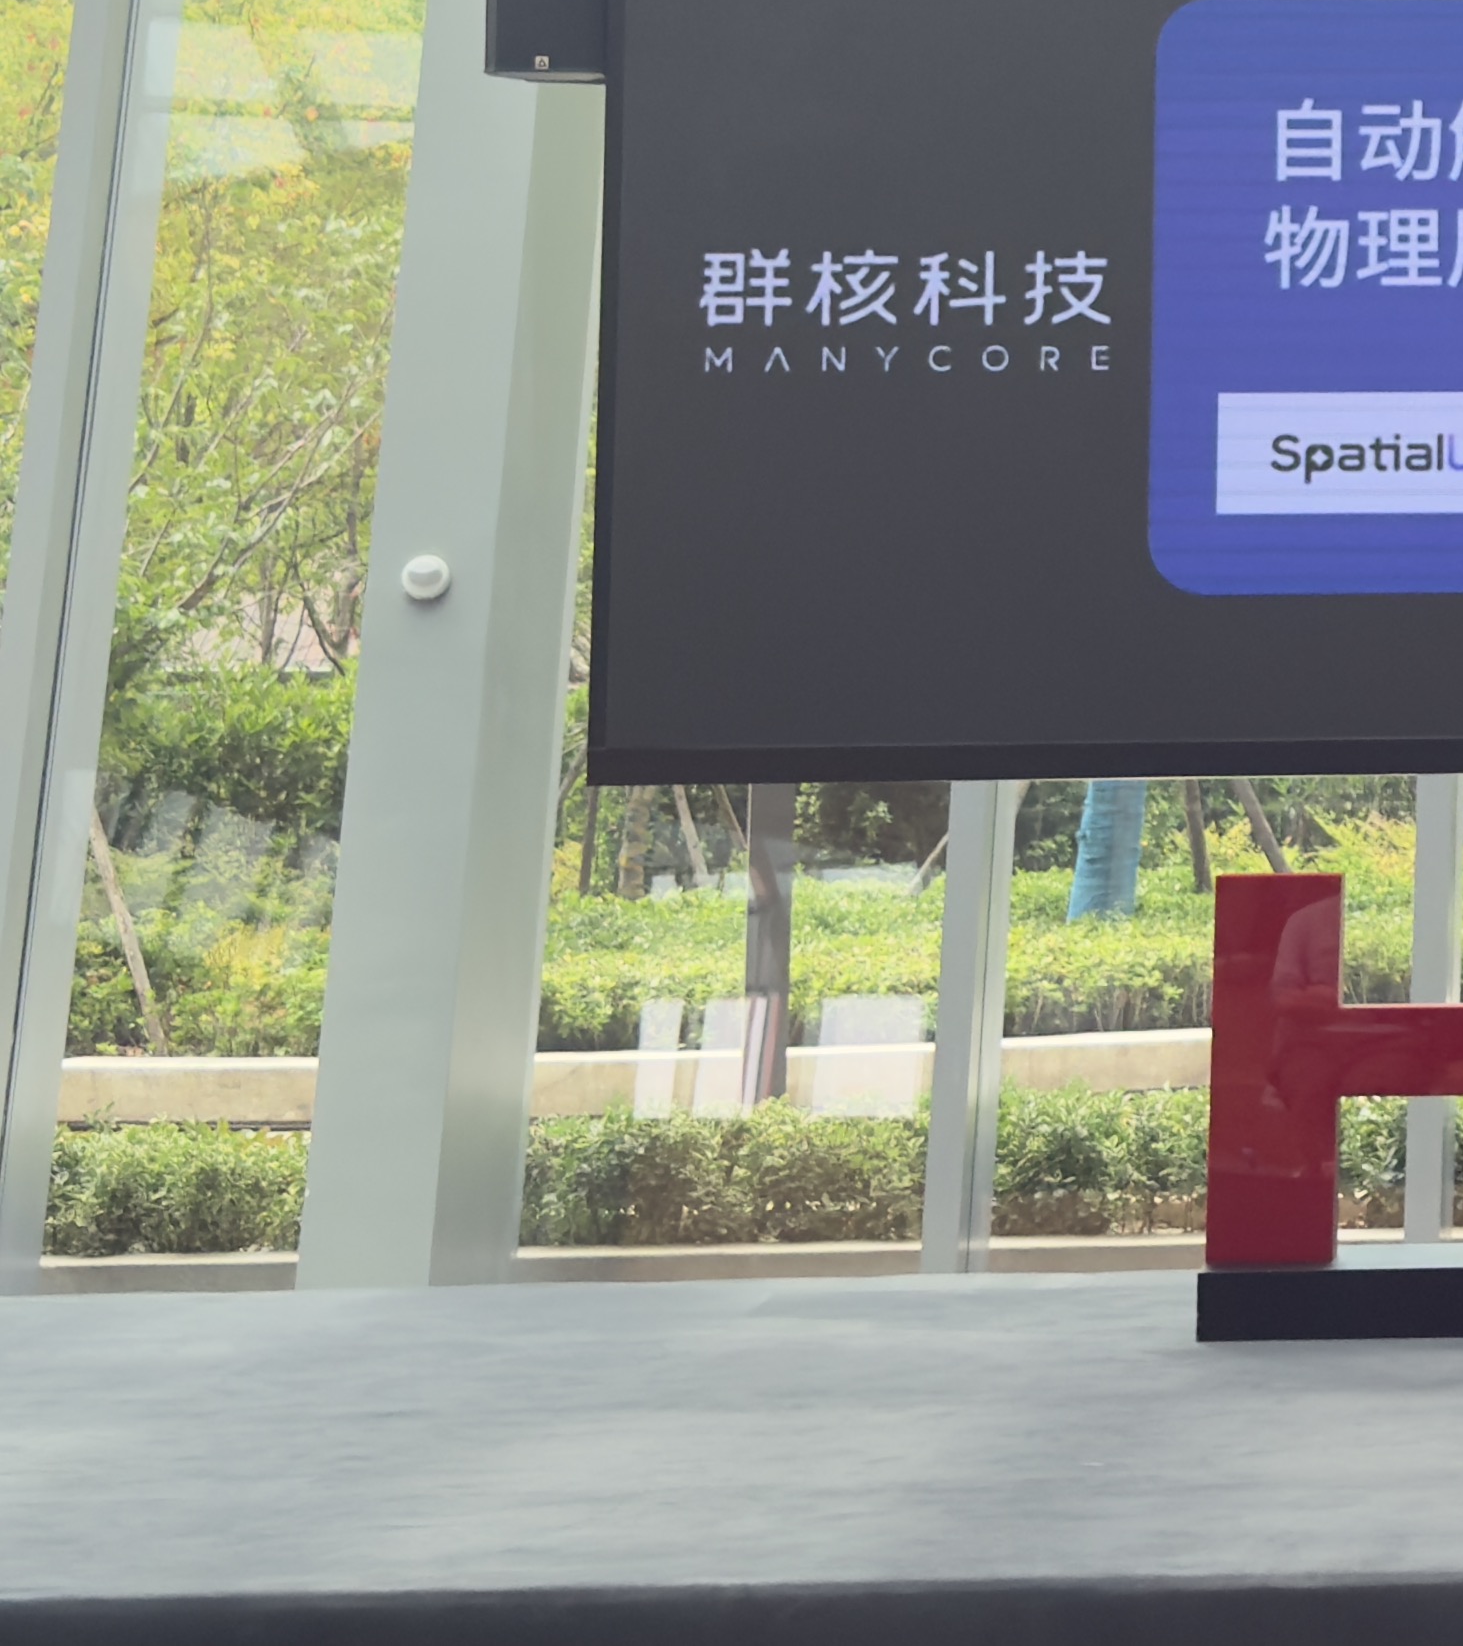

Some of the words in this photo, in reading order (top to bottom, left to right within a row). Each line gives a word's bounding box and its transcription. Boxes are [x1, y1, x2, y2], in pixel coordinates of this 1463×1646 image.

[699, 248, 1111, 327] 群核科技
[703, 344, 1111, 373] MANYCORE
